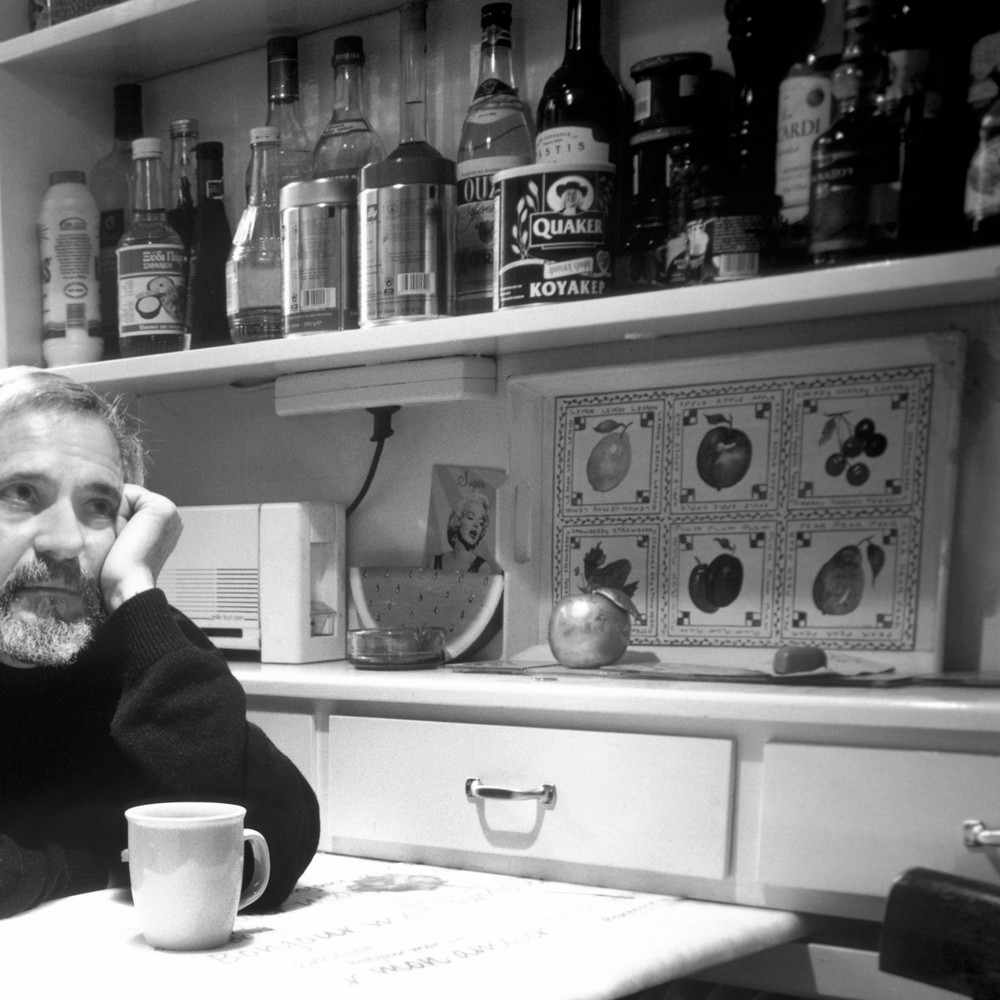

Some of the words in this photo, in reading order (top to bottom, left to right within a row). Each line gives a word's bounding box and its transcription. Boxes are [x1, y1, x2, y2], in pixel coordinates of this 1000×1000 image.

[532, 217, 603, 240] QUAKER
[457, 470, 486, 492] Sugar
[368, 956, 451, 974] mon
